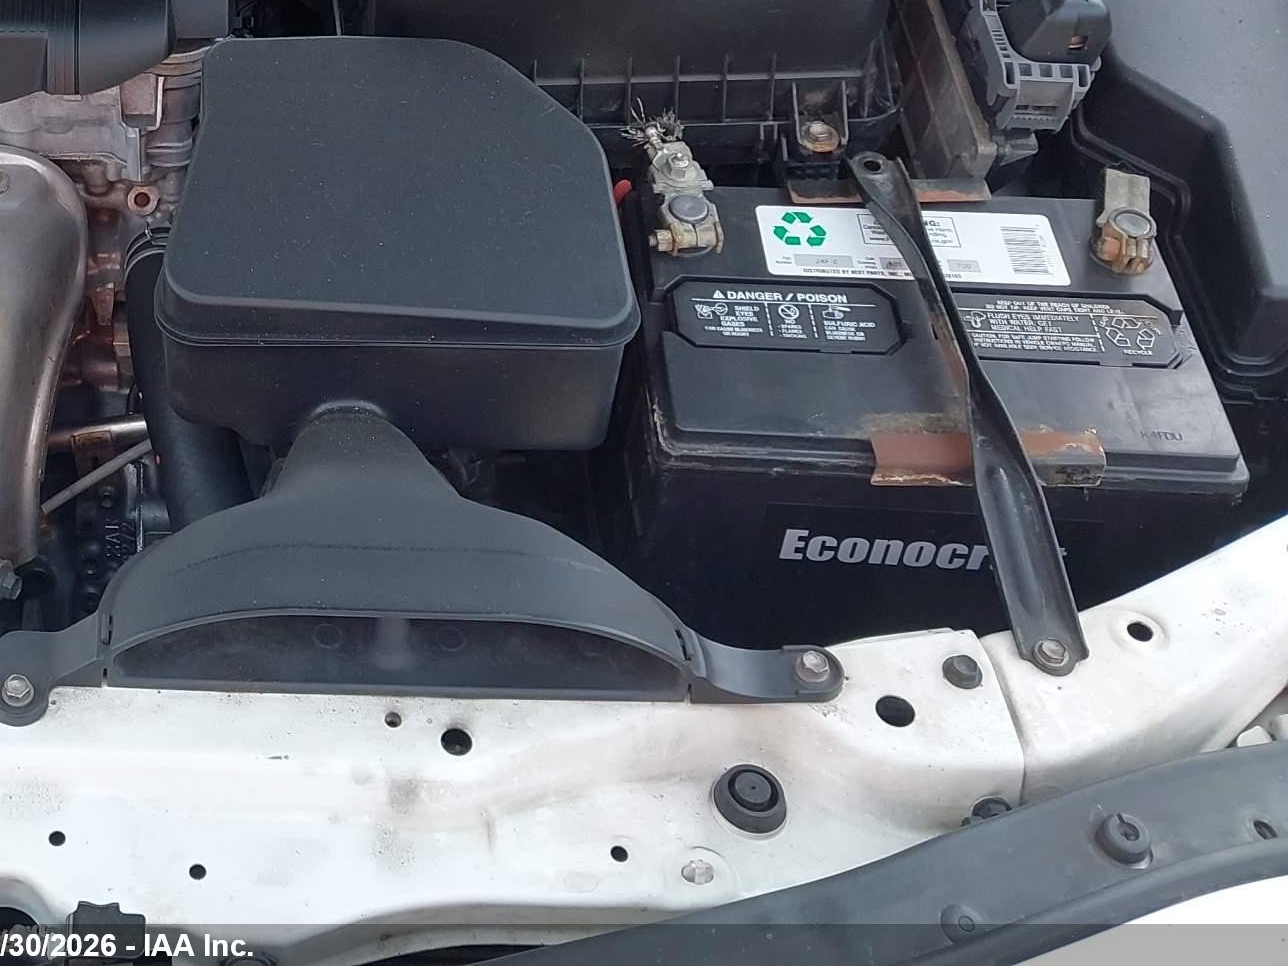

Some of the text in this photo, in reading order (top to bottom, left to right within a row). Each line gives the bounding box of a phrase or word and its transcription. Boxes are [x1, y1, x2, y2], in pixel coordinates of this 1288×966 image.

[727, 291, 848, 303] DANGER / POISON
[1032, 314, 1079, 322] IMMEDIATELY
